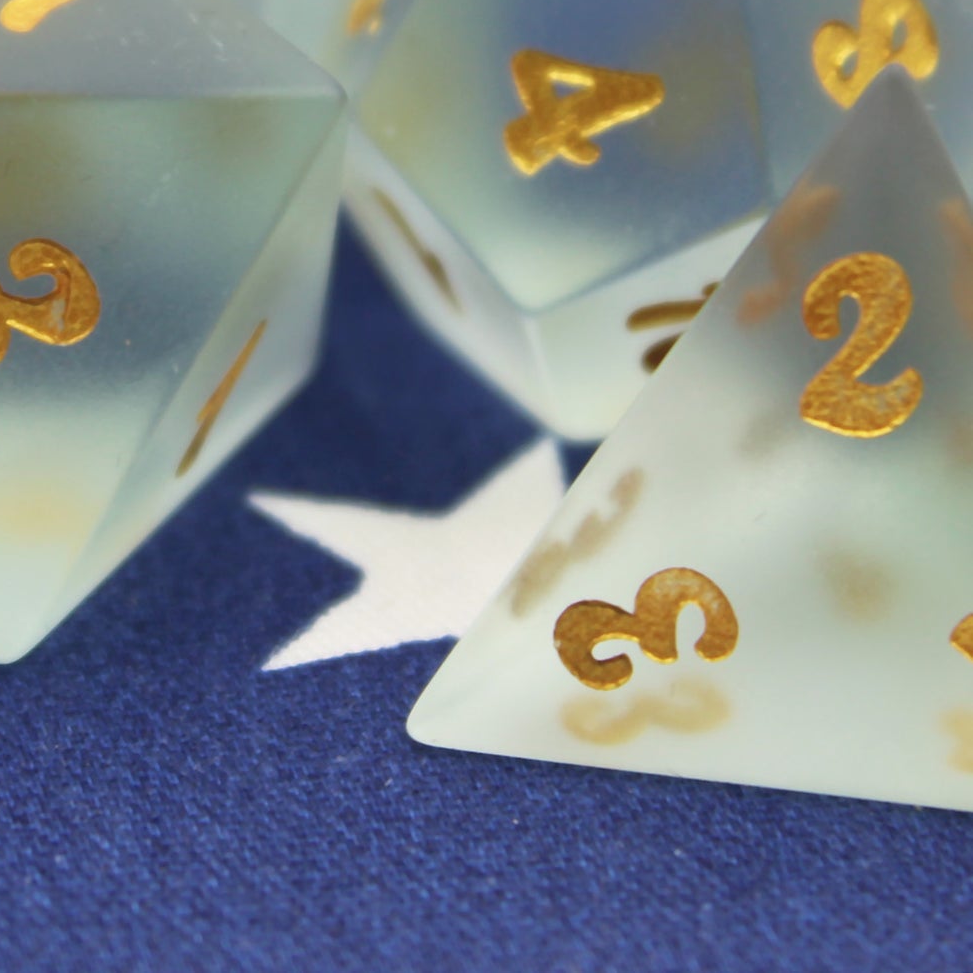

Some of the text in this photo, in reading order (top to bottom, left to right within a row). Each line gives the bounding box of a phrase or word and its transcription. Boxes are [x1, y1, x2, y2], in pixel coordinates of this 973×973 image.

[503, 47, 667, 177] 4
[799, 250, 922, 439] 2
[553, 566, 739, 691] 3
